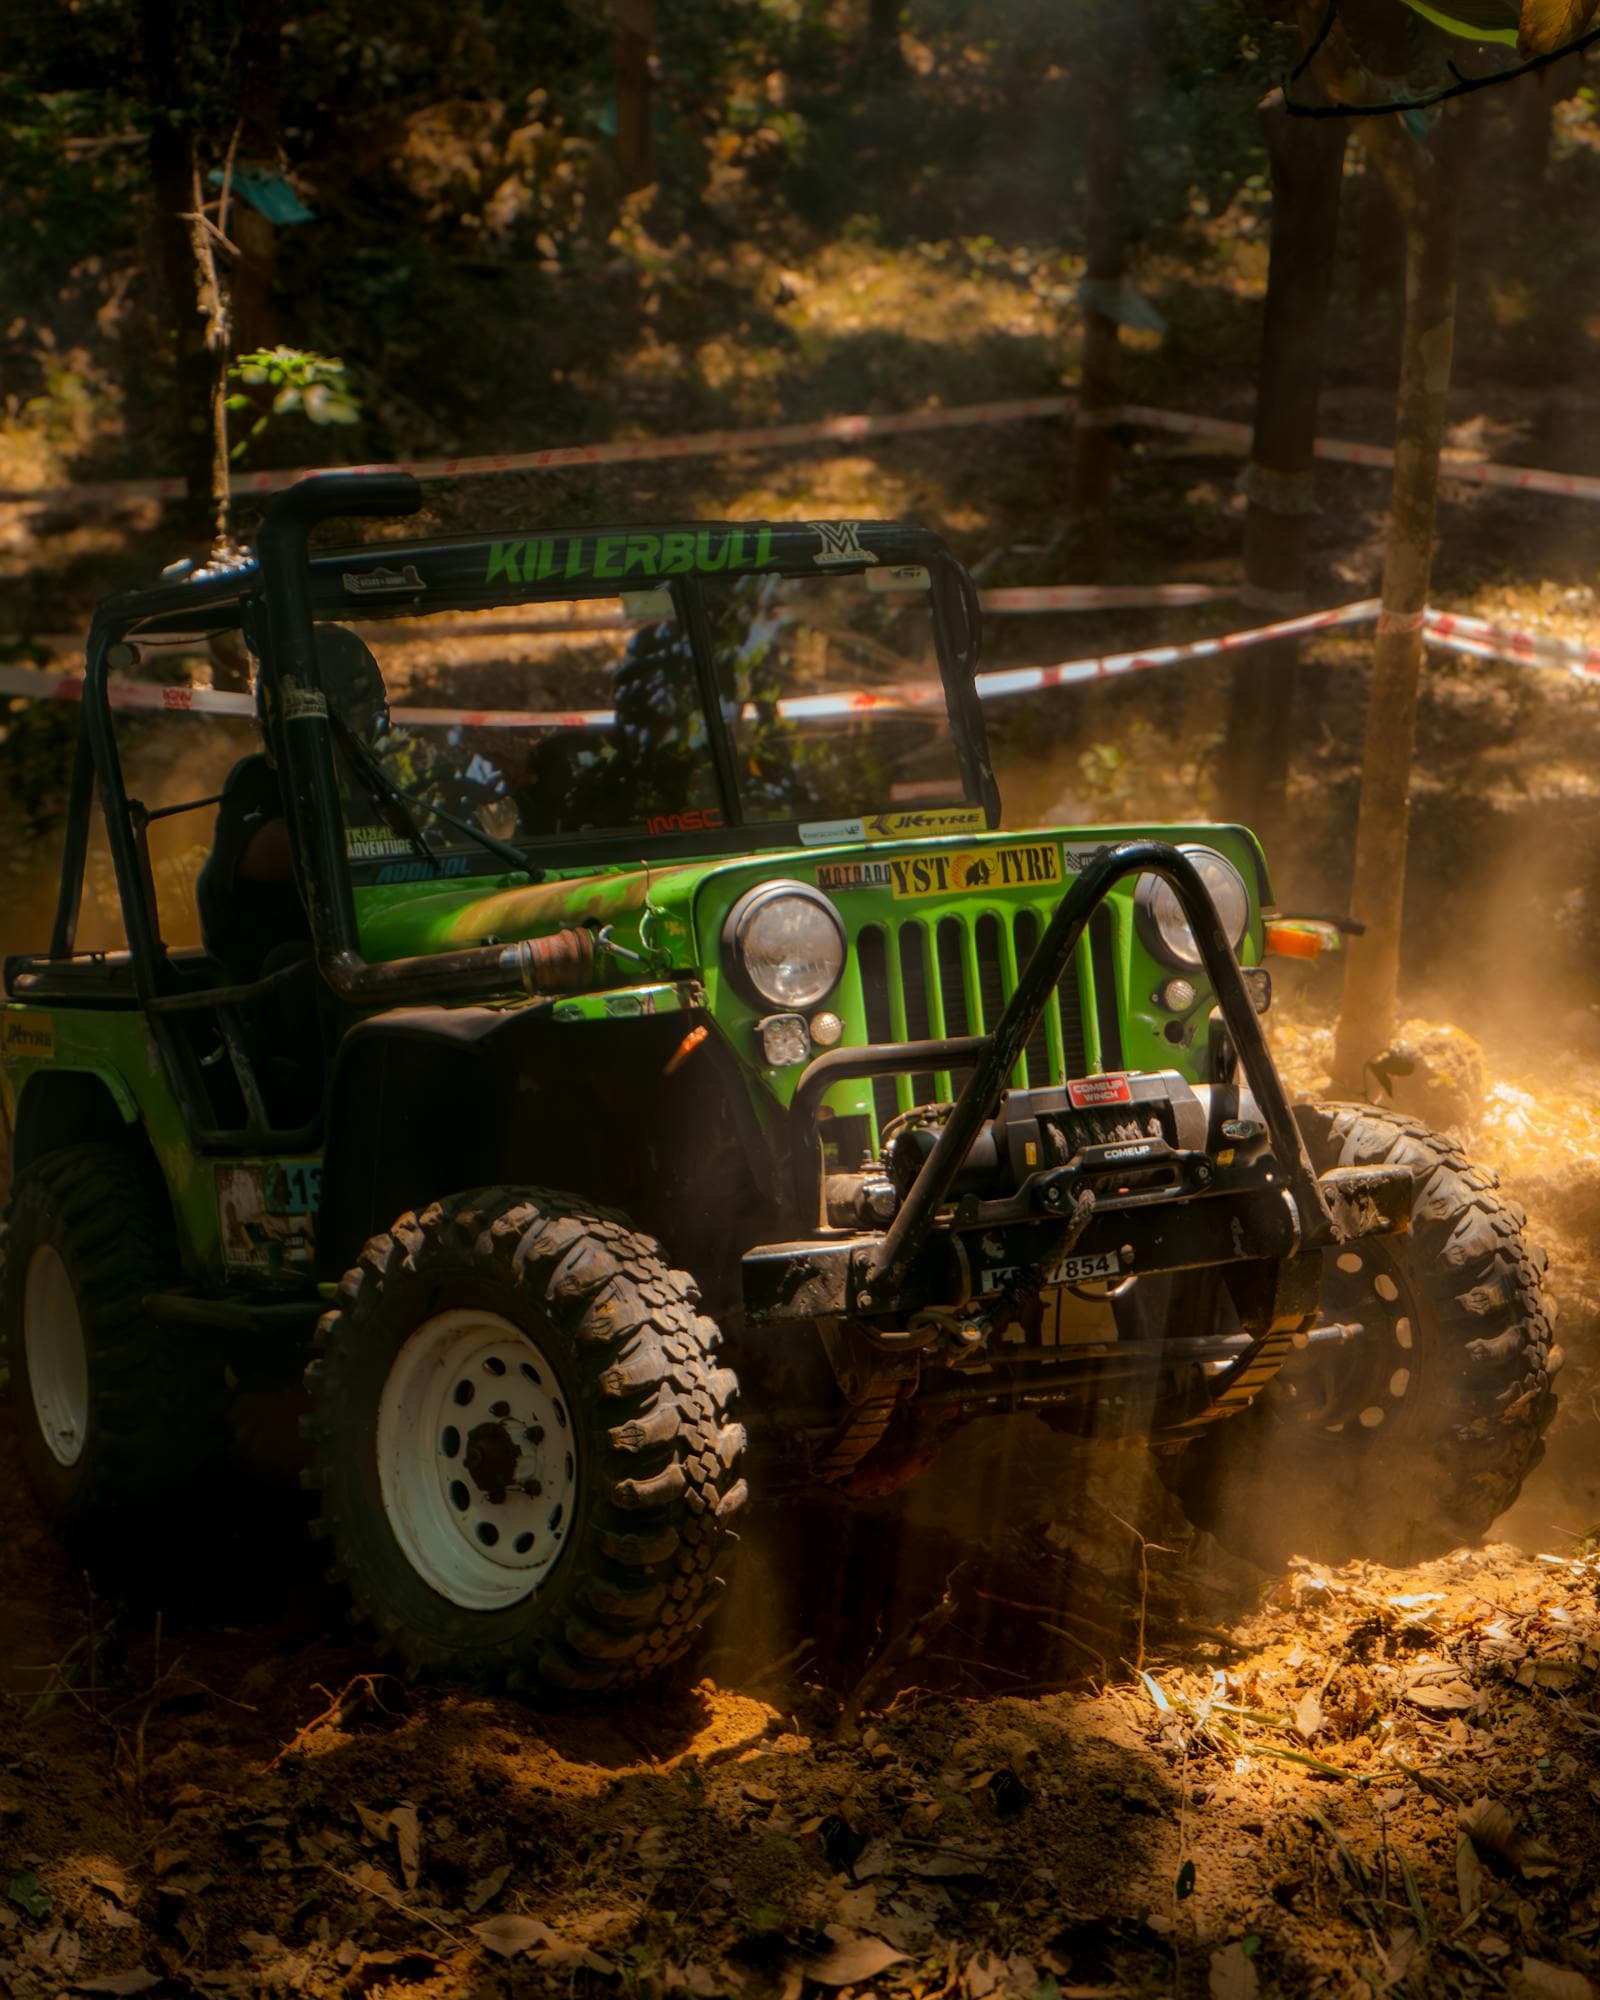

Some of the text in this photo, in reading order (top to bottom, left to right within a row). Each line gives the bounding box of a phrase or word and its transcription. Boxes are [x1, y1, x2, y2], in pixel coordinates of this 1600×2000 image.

[485, 528, 779, 584] KILLERBULL
[890, 856, 950, 895] YST
[995, 847, 1057, 884] TYRE
[1072, 1080, 1123, 1093] COMEUP
[1083, 1091, 1119, 1102] WINCH
[1104, 1145, 1150, 1160] COMEUP
